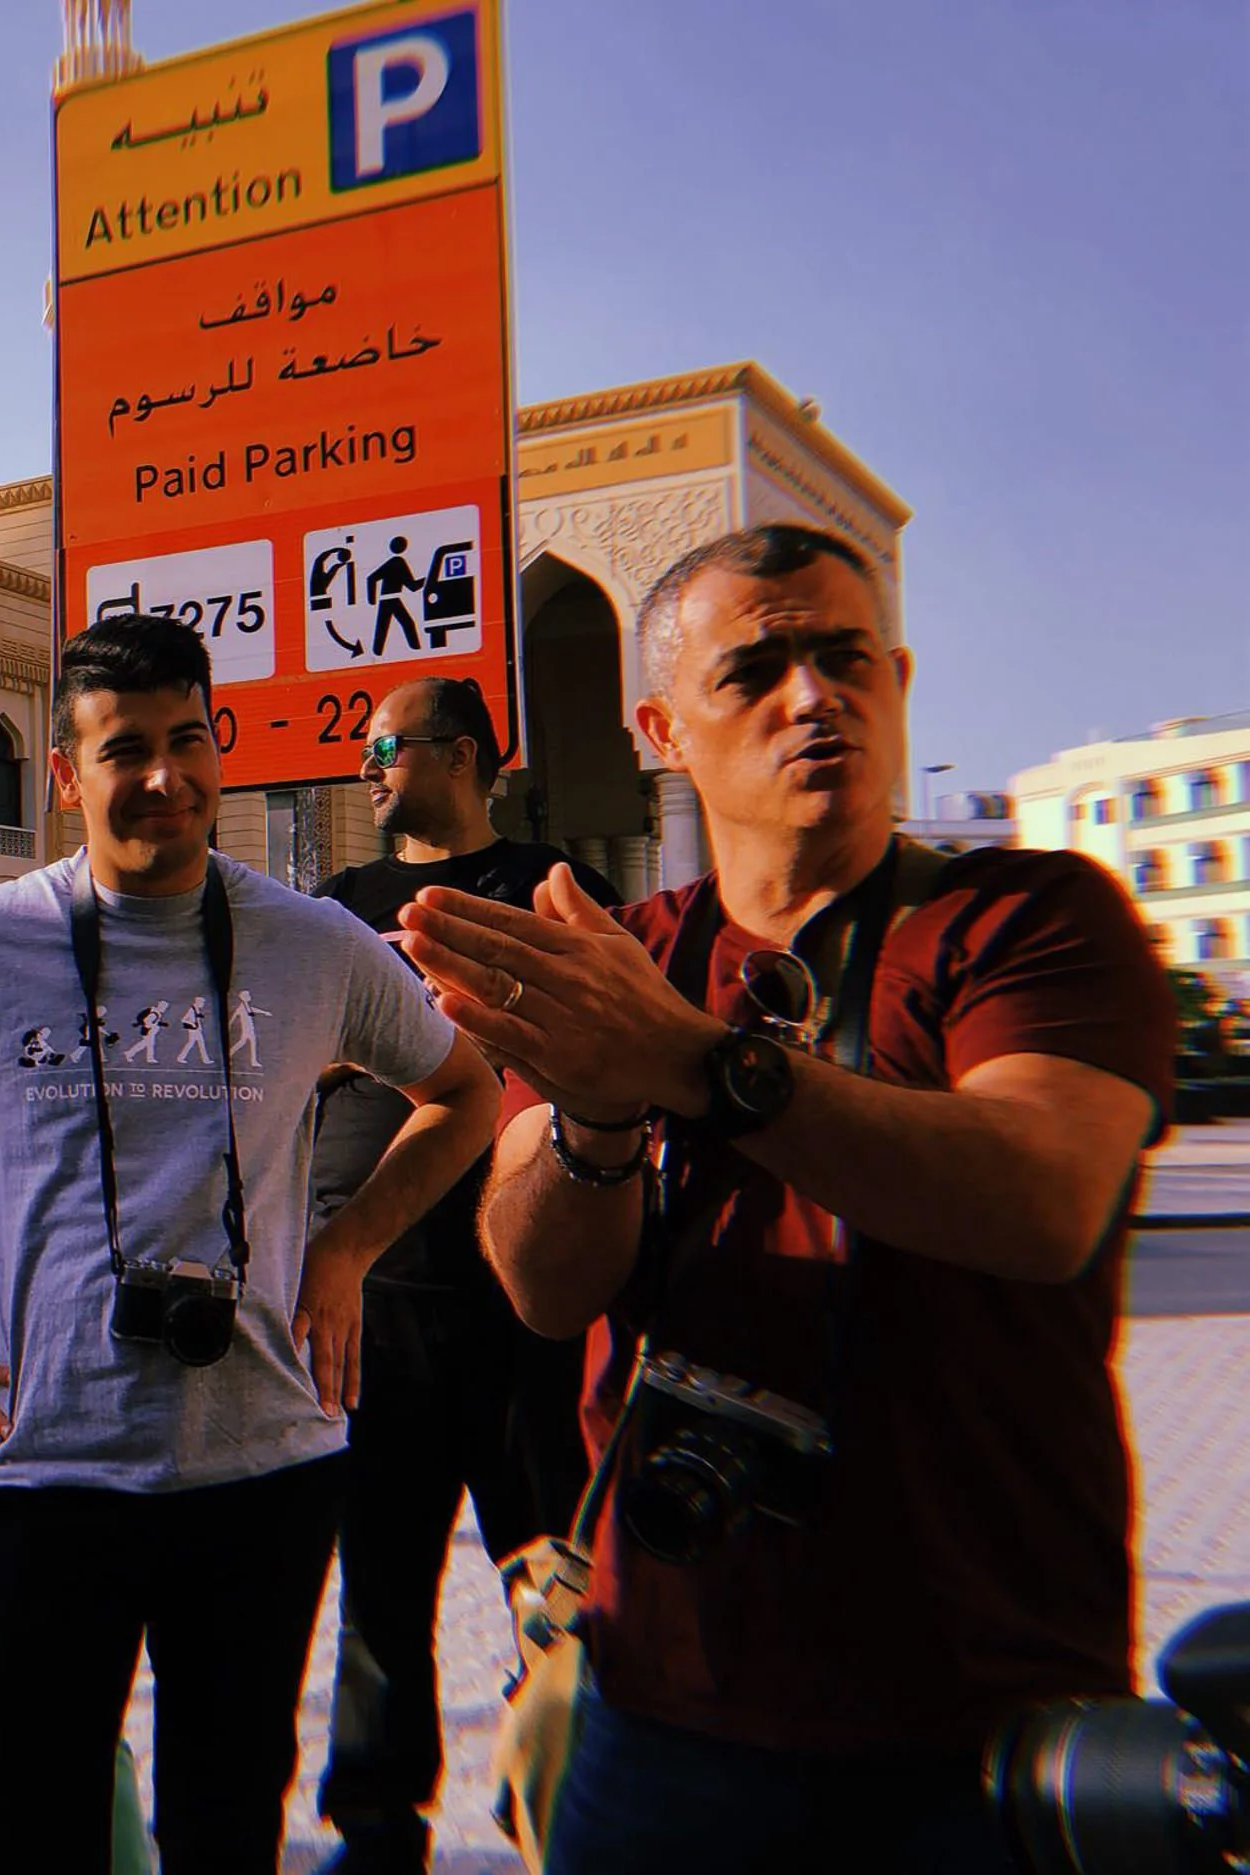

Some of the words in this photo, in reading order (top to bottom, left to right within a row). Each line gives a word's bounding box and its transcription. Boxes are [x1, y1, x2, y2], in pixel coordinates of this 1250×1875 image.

[110, 68, 270, 150] تنبيه
[354, 33, 450, 178] P
[85, 168, 303, 249] Attention
[198, 277, 338, 331] مواقف
[277, 323, 442, 381] خاضعة
[107, 355, 254, 437] للرسوم
[135, 450, 226, 502] Paid
[244, 424, 417, 482] Parking
[130, 1083, 147, 1097] TO
